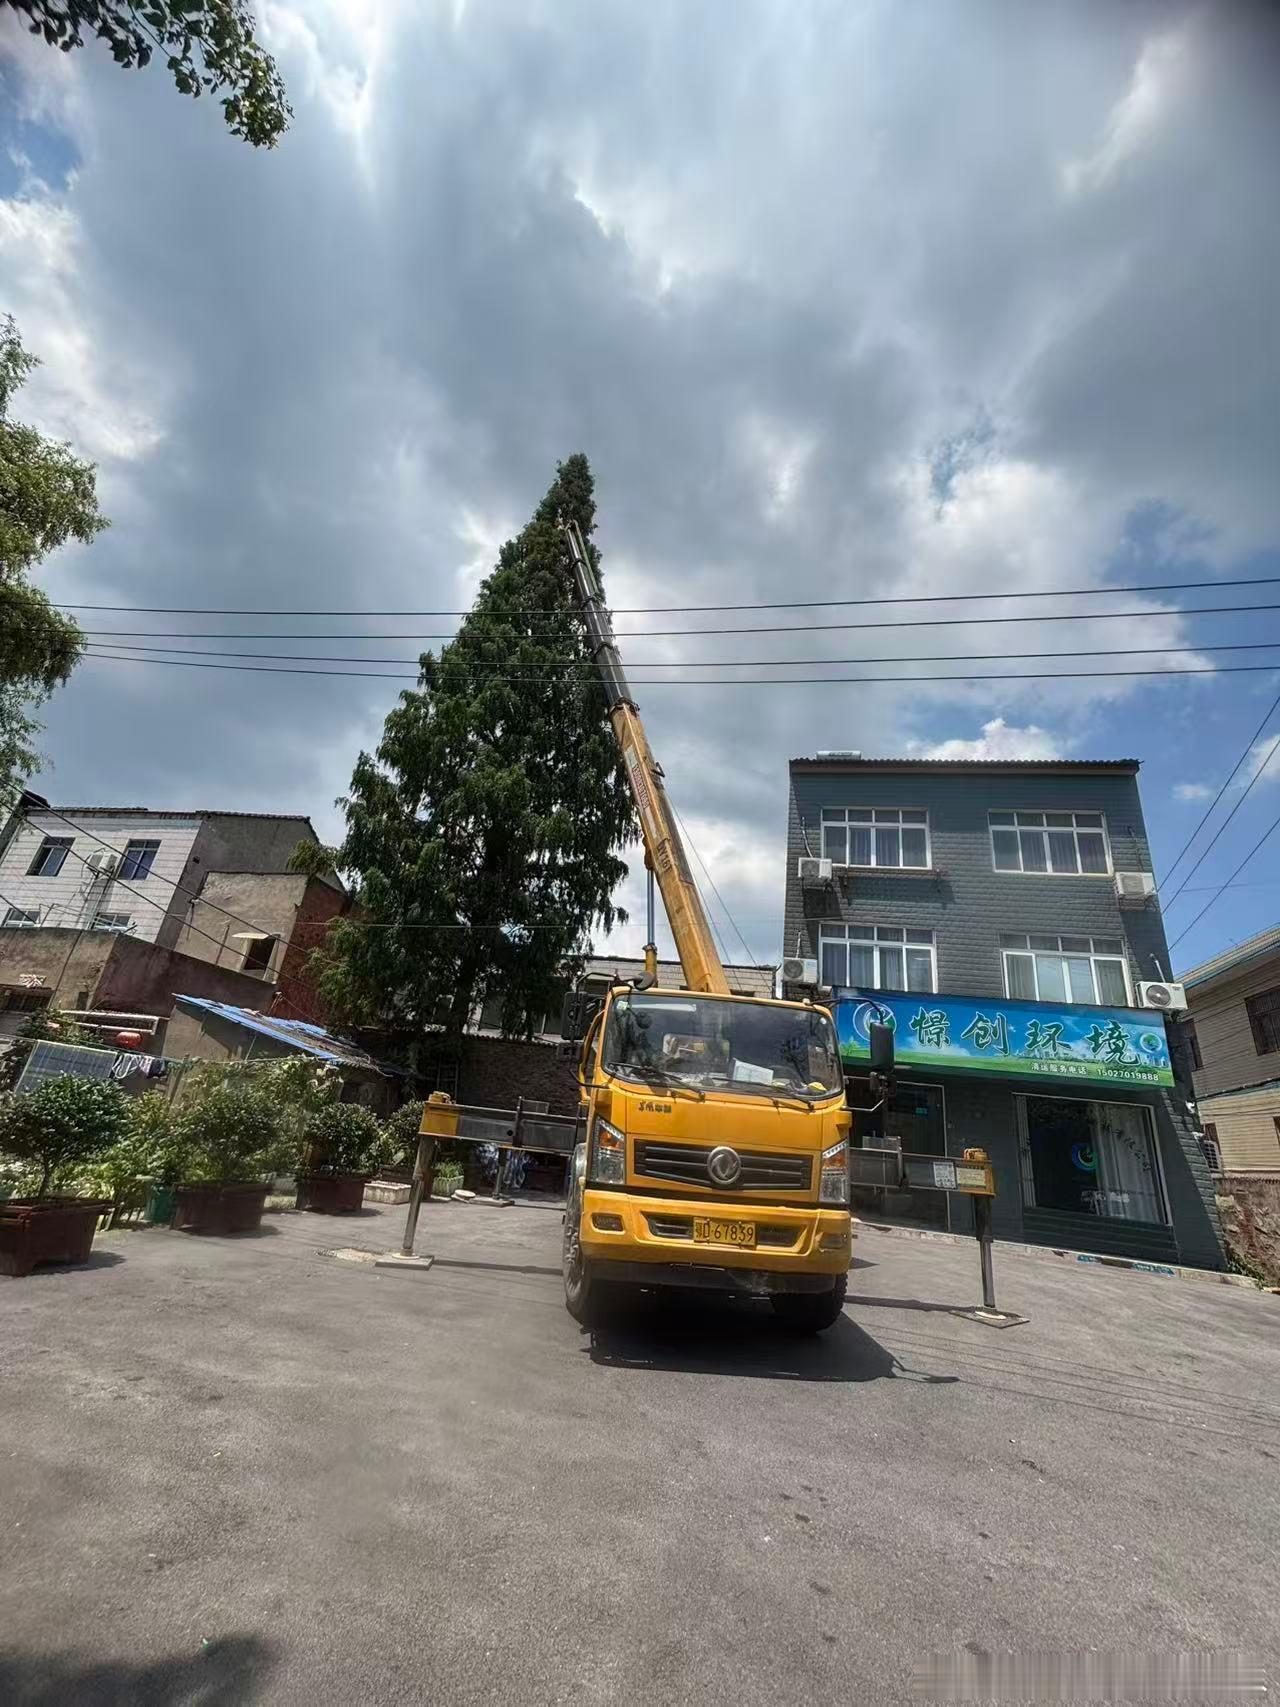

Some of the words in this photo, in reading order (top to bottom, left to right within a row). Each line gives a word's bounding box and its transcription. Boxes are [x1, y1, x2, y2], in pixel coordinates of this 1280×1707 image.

[909, 1006, 1140, 1065] 憬创环境
[1097, 1068, 1160, 1081] 15027019888
